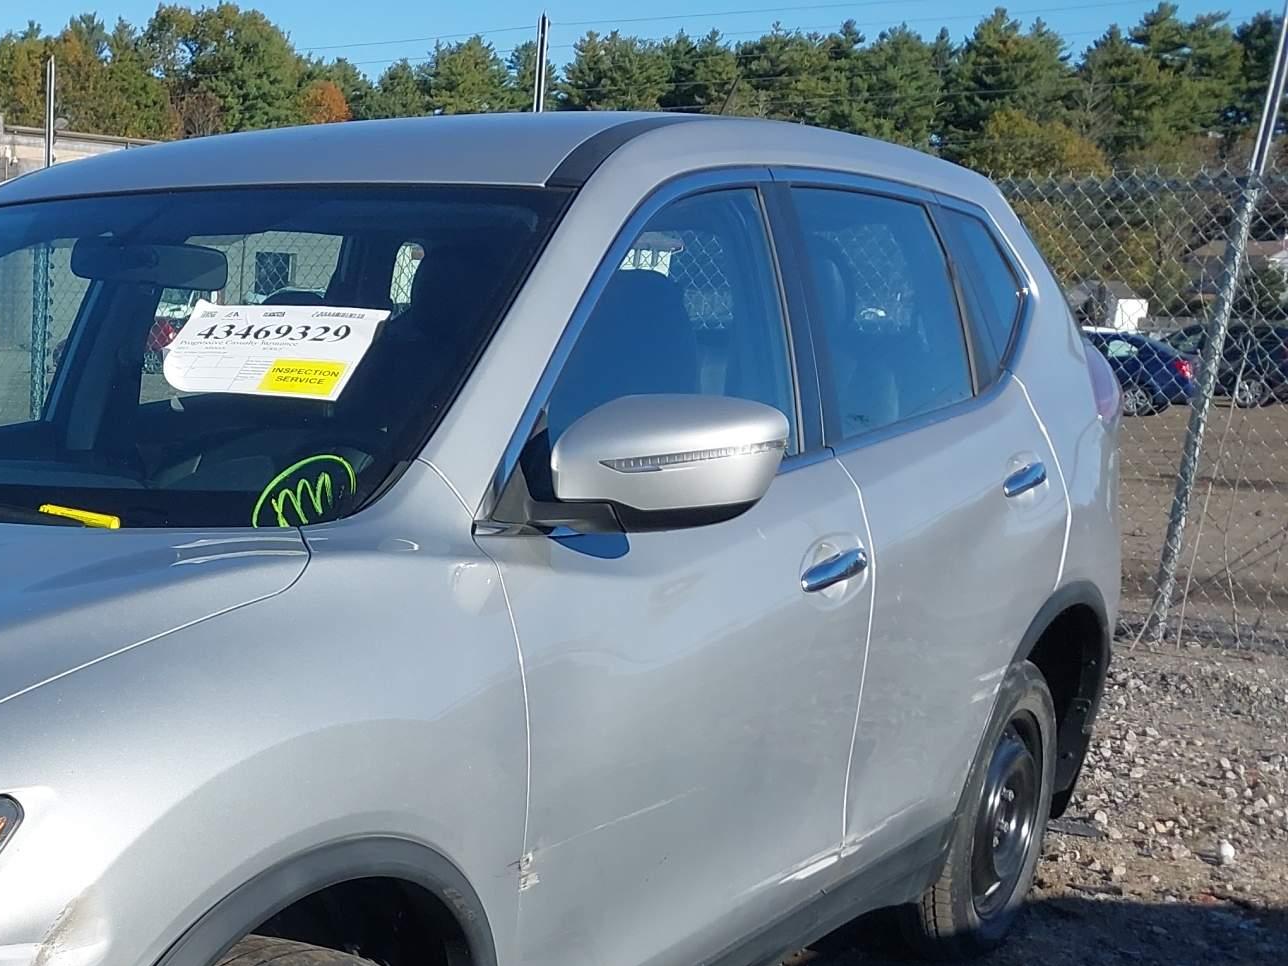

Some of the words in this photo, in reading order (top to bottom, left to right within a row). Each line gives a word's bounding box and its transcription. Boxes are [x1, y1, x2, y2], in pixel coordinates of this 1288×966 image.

[197, 323, 351, 343] 43469329
[271, 366, 340, 378] INSPECTION
[274, 375, 326, 385] SERVICE
